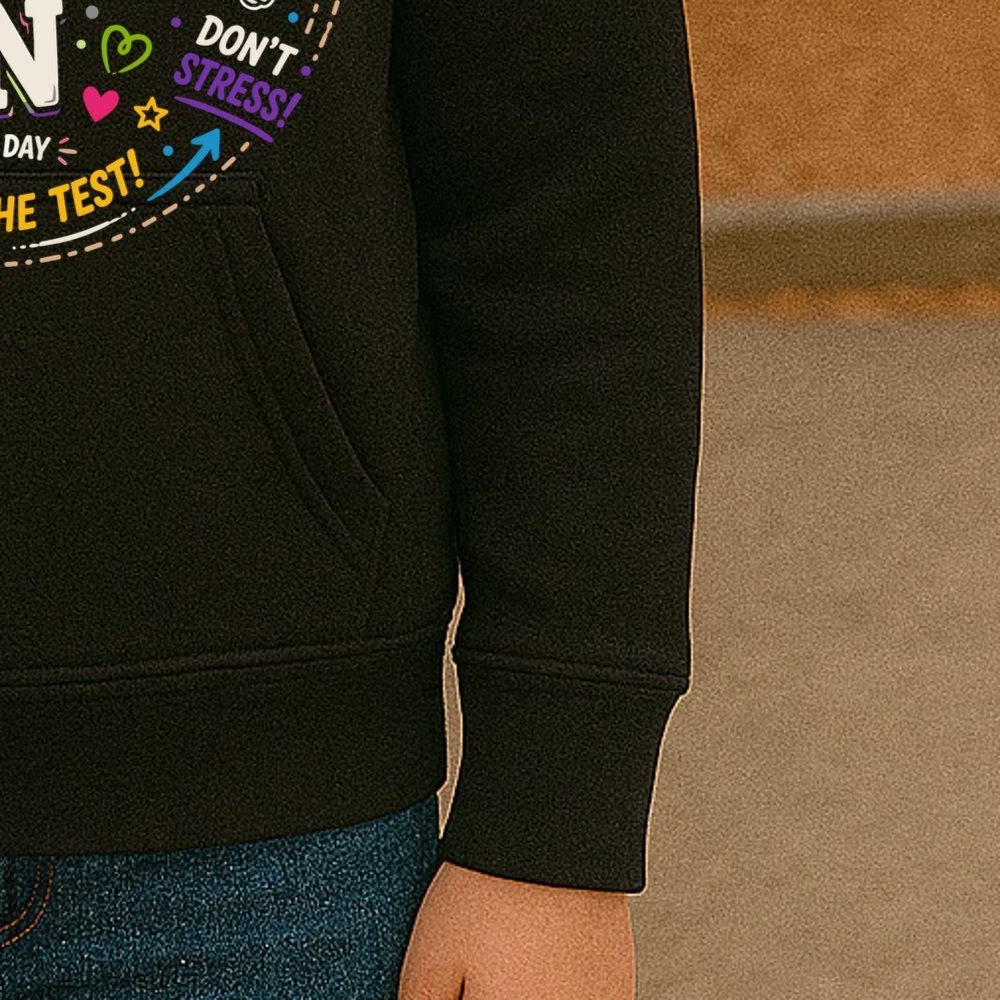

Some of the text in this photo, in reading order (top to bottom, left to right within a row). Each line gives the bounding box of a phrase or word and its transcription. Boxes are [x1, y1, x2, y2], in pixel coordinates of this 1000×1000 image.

[195, 14, 299, 77] DON'T
[173, 52, 301, 128] STRESS!
[2, 134, 51, 161] DAY
[48, 148, 144, 223] TEST!
